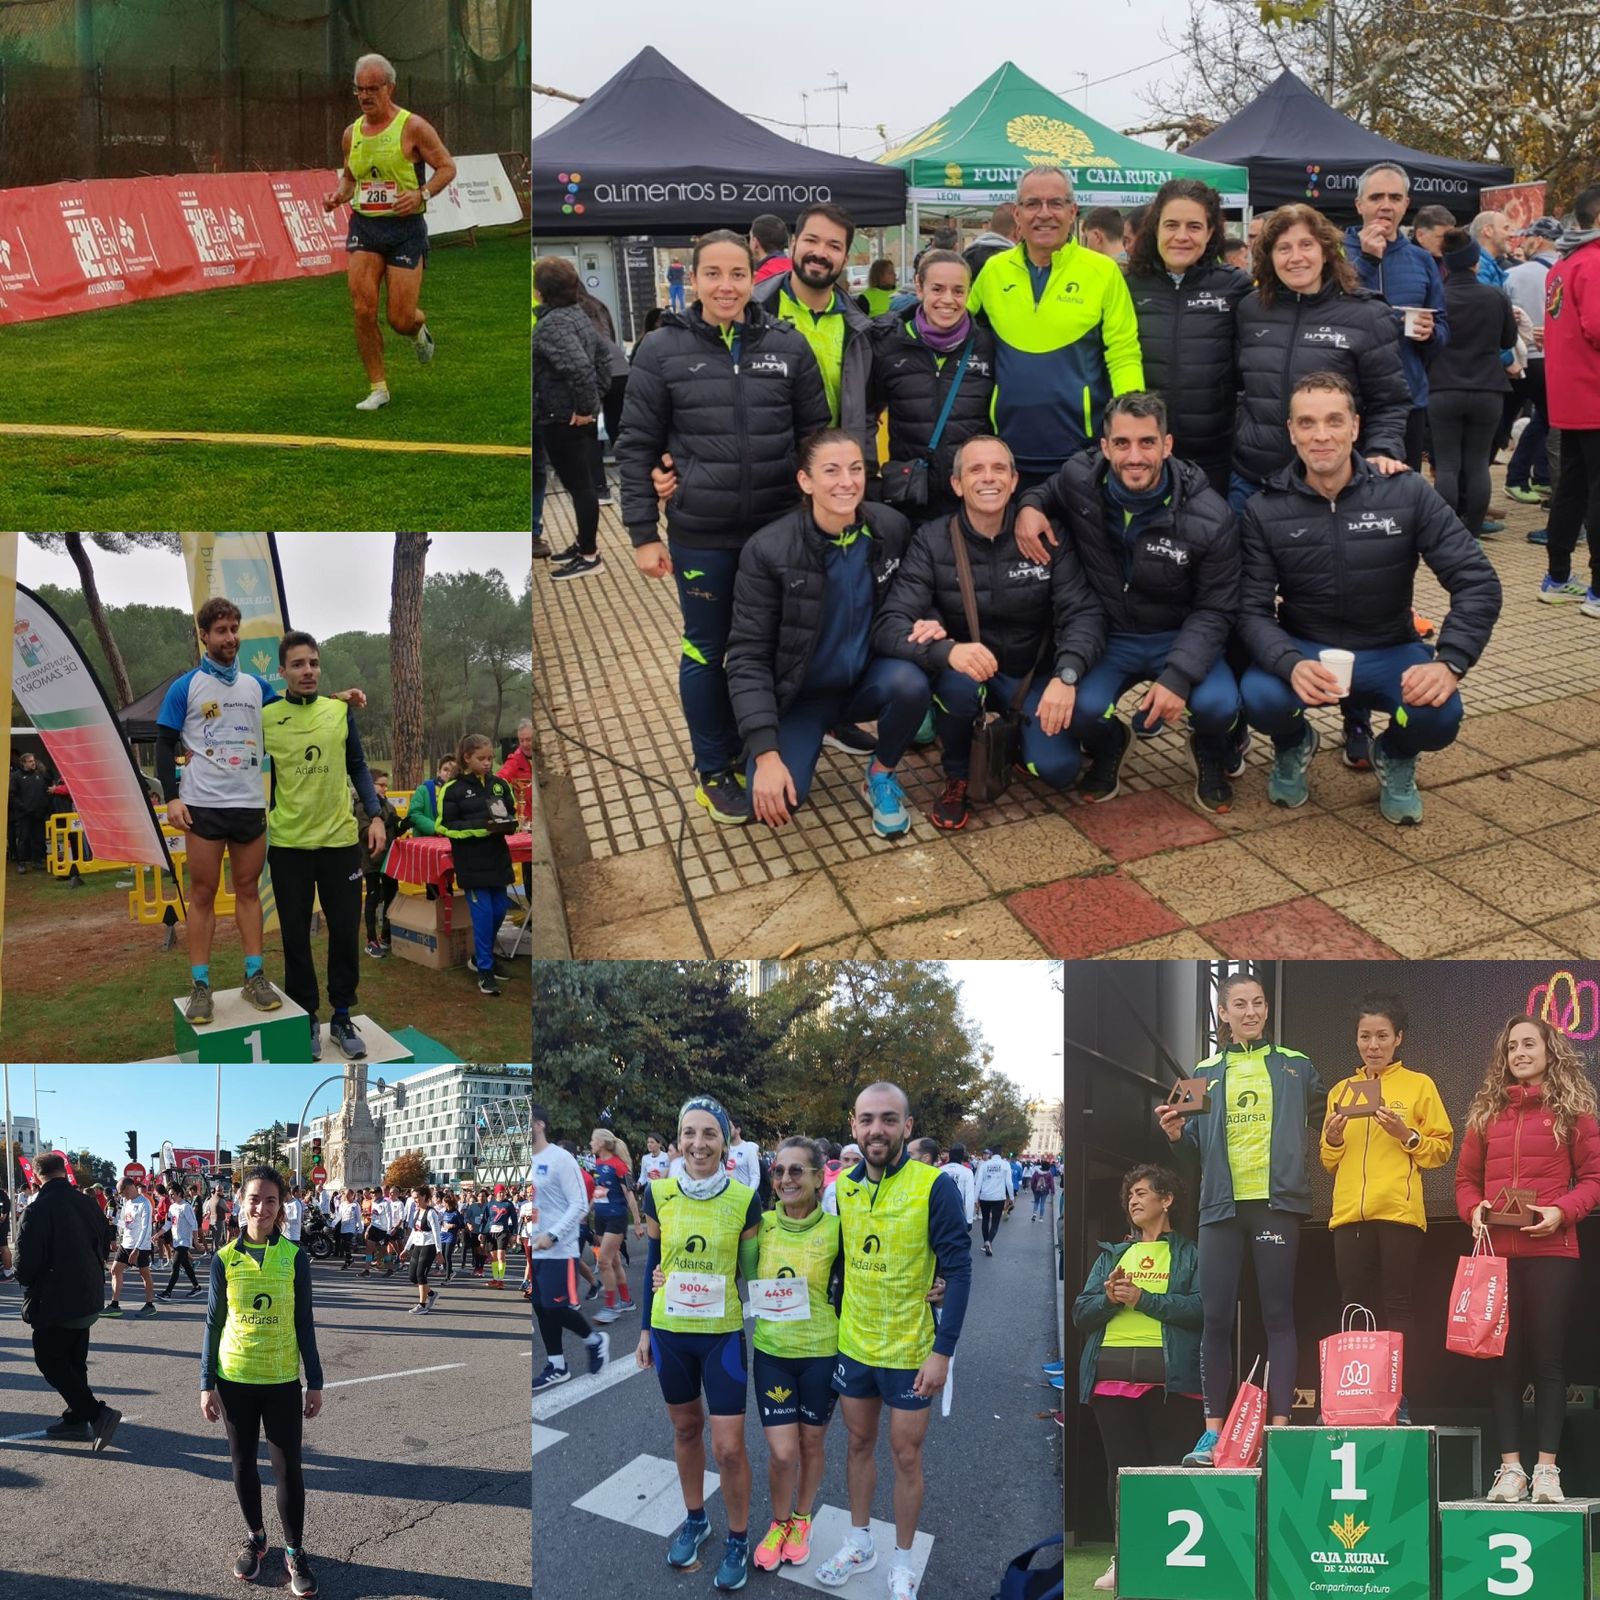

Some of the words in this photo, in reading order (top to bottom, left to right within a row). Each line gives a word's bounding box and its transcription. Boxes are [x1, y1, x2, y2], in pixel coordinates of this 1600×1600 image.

[1086, 169, 1125, 184] CAJA
[1413, 177, 1468, 193] zamora
[366, 190, 388, 203] 236
[594, 183, 716, 202] alimentos
[743, 184, 832, 203] zamora
[936, 192, 961, 201] LEÓN
[295, 766, 329, 775] Adarsa
[244, 1030, 270, 1064] 1
[1226, 1113, 1266, 1125] Adarsa
[673, 1257, 713, 1270] Adarsa
[851, 1257, 887, 1273] Adarsa
[680, 1283, 709, 1293] 9004
[765, 1288, 793, 1298] 4436
[241, 1313, 279, 1325] Adarsa
[1240, 1421, 1260, 1459] CASTILLA
[1331, 1442, 1367, 1500] 1
[1165, 1509, 1206, 1567] 2
[1310, 1551, 1342, 1564] CAJA
[1344, 1552, 1389, 1565] RURAL
[1487, 1533, 1535, 1596] 3
[1324, 1564, 1335, 1573] DE
[1338, 1564, 1375, 1574] ZAMORA
[1309, 1581, 1363, 1594] Compartimos
[1363, 1582, 1390, 1596] futuro
